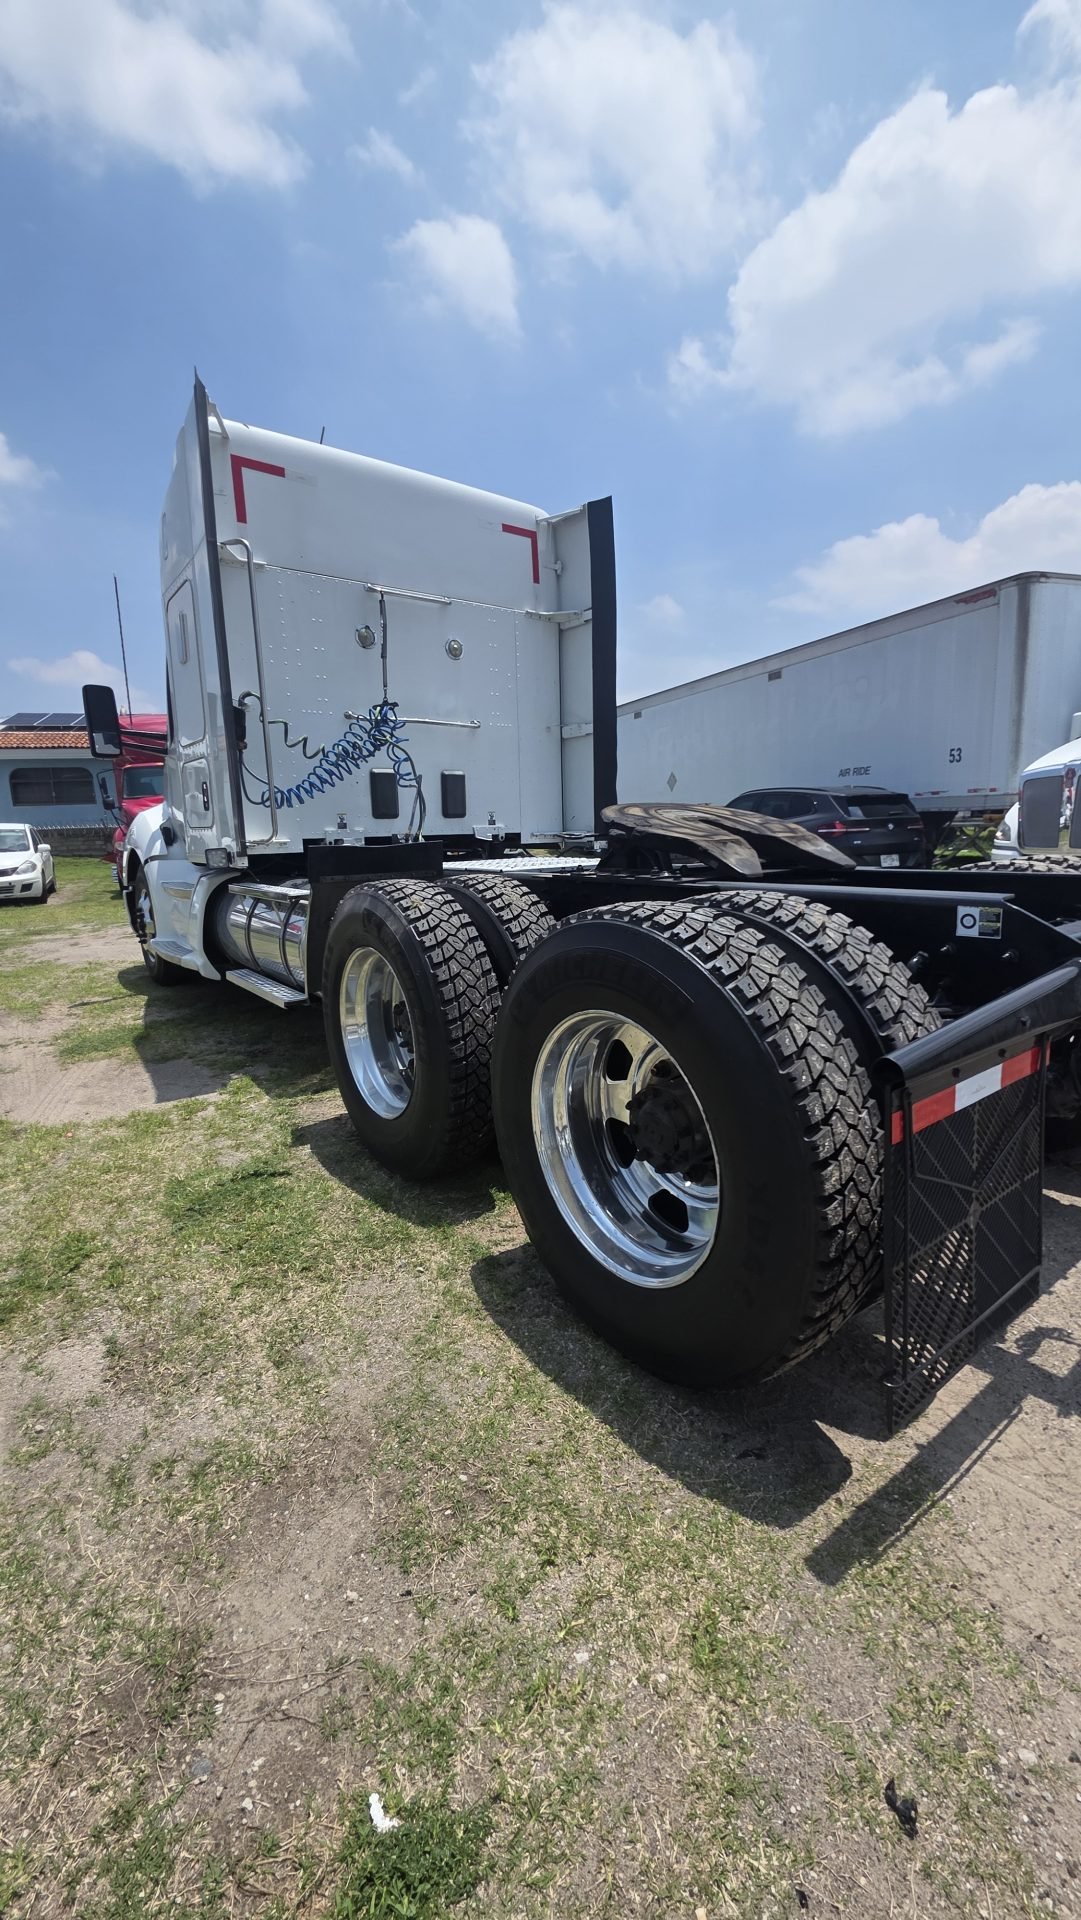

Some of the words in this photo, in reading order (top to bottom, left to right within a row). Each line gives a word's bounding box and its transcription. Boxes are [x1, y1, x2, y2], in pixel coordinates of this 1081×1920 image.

[949, 747, 962, 763] 53
[838, 767, 851, 778] AIR
[852, 765, 872, 776] RIDE
